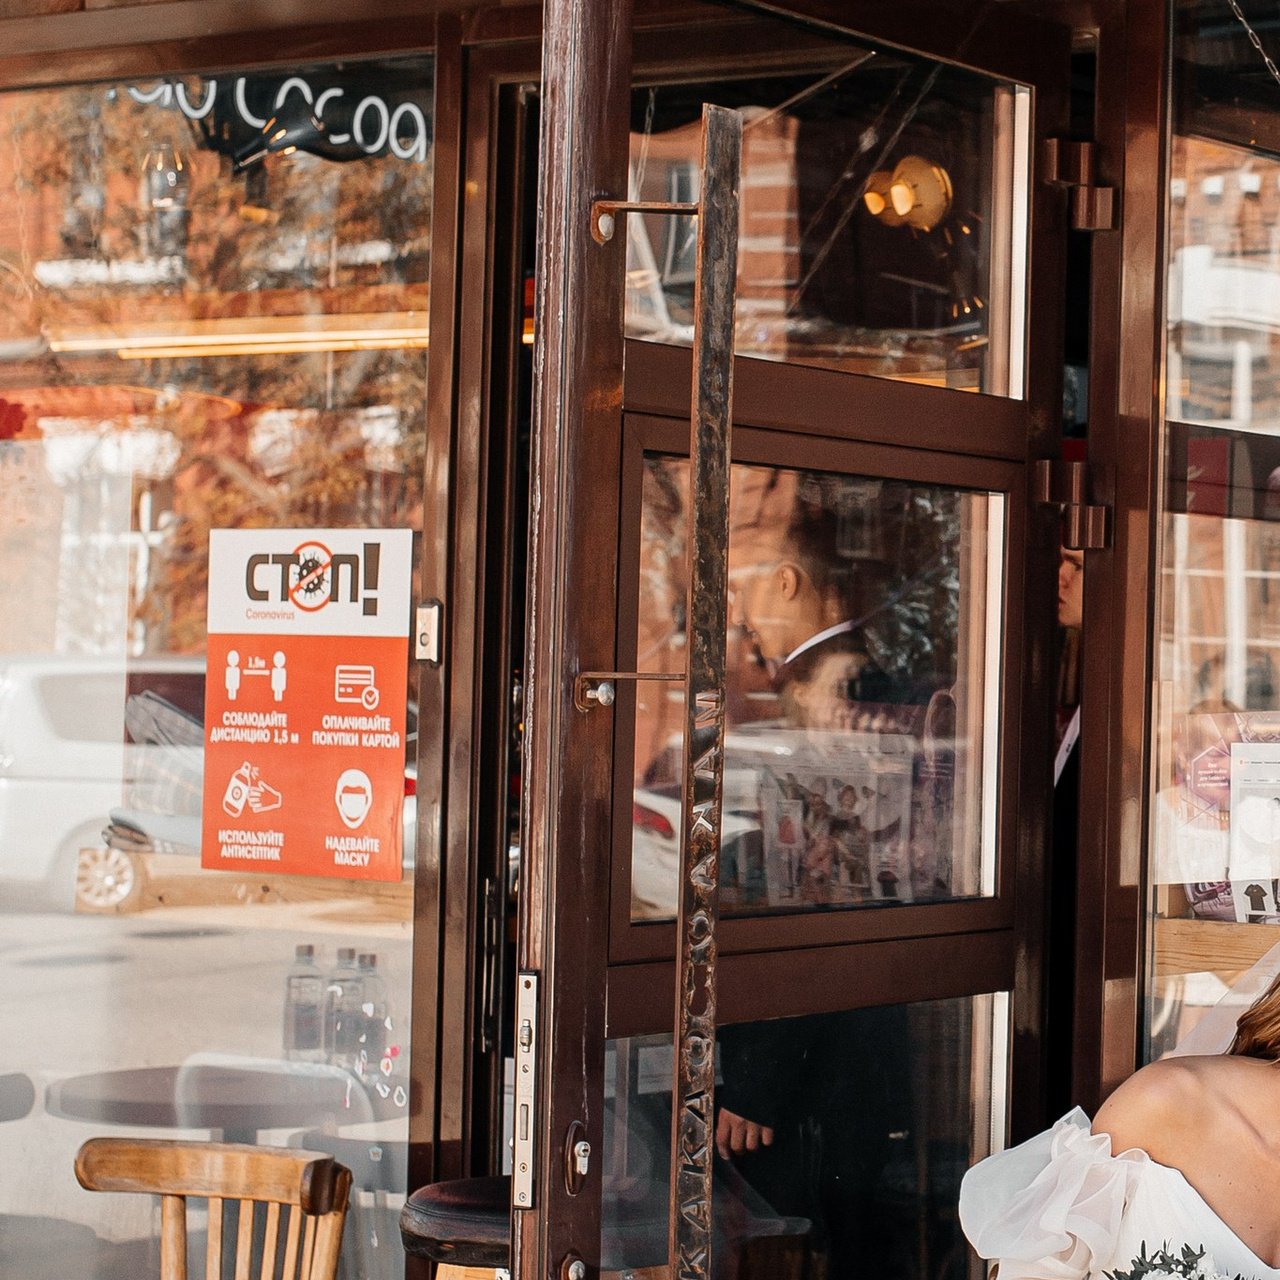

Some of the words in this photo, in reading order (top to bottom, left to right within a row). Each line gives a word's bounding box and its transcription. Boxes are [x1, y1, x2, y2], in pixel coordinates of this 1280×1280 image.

[245, 608, 295, 620] Coronavirus
[222, 711, 287, 728] СОБЛЮДАЙТЕ
[322, 715, 391, 732] ОПЛАЧИВАЙТЕ
[210, 726, 271, 743] ДИСТАНЦИЮ
[273, 729, 288, 745] 1,5
[312, 731, 359, 747] ПОКУПКИ
[362, 731, 400, 749] КАРТОЙ
[218, 829, 284, 847] ИСПОЛЬЗУЙТЕ
[325, 835, 380, 853] НАДЕВАЙТЕ
[221, 844, 281, 861] АНТИСЕПТИК
[334, 852, 370, 867] МАСКУ
